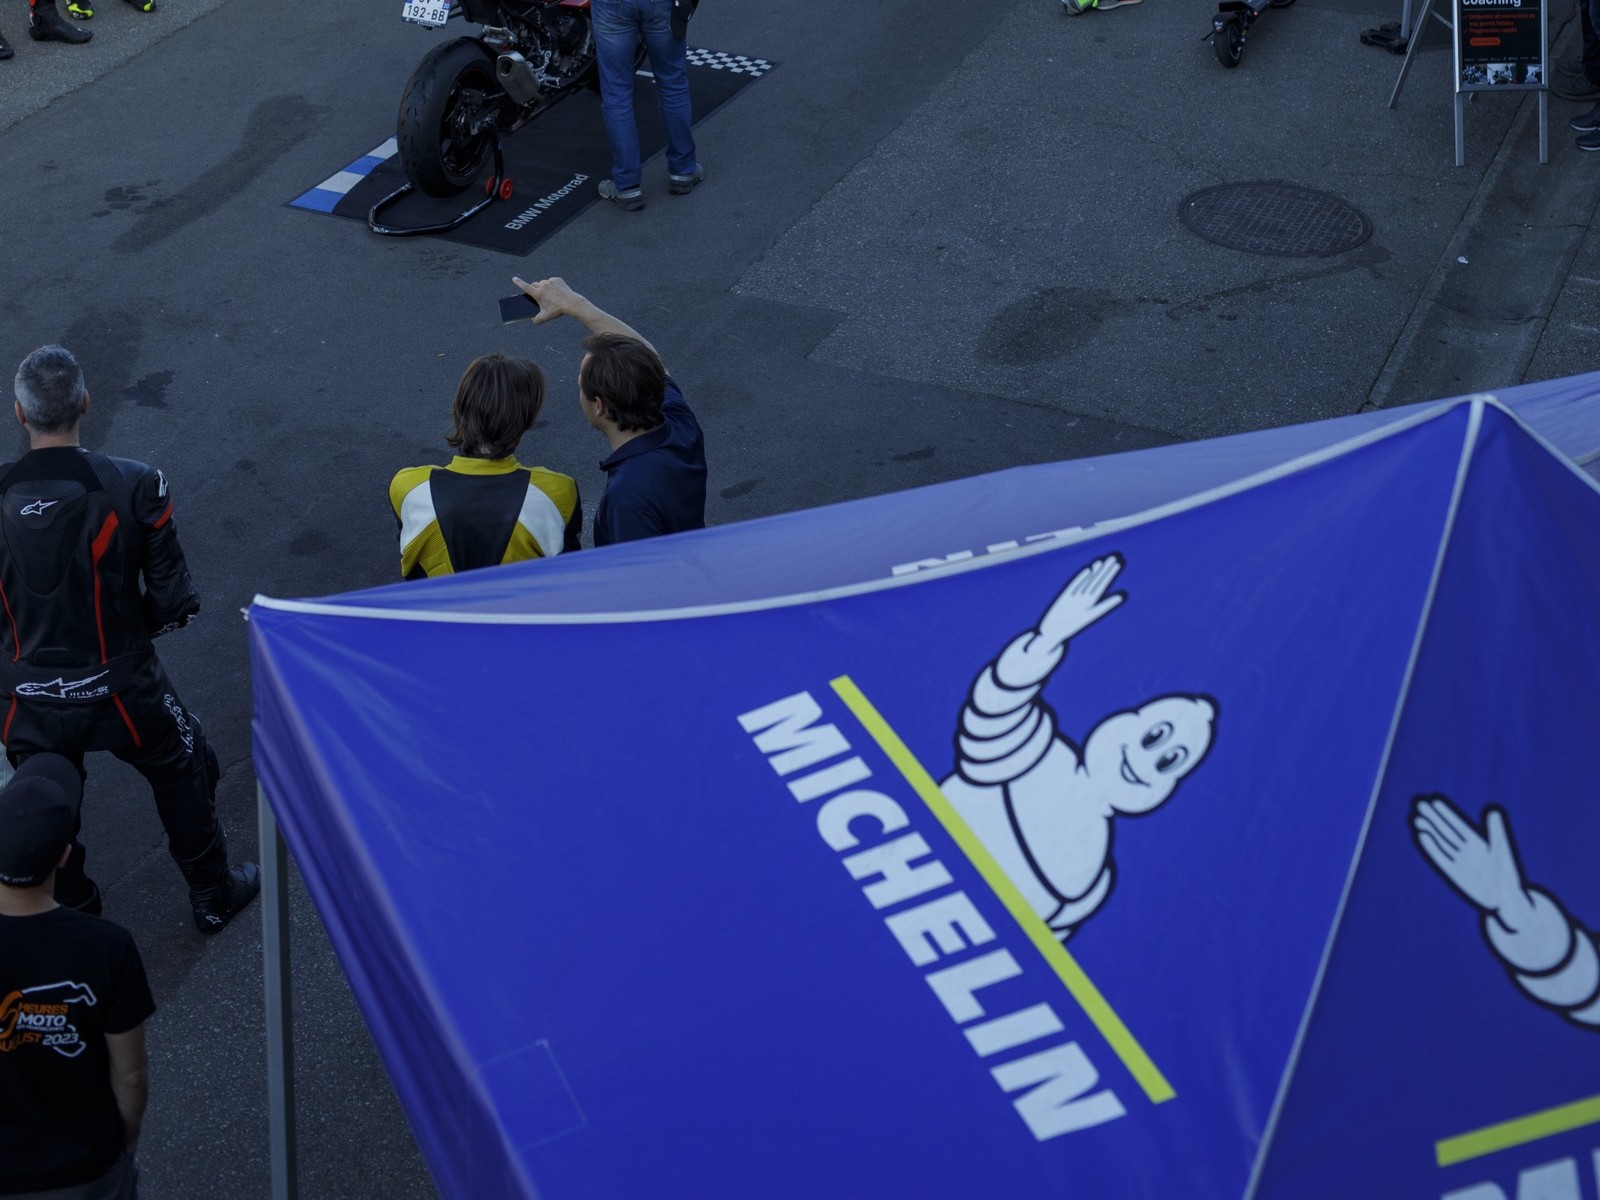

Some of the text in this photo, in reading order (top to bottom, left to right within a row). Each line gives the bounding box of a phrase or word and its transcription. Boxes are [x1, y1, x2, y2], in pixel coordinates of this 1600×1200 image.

[407, 5, 446, 22] 192-BB
[504, 207, 542, 231] BMW
[537, 173, 589, 210] Motorrad
[736, 690, 1128, 1142] MICHELIN
[18, 1002, 69, 1014] HEURES
[17, 1012, 67, 1027] MOTO
[42, 1033, 79, 1047] 2023
